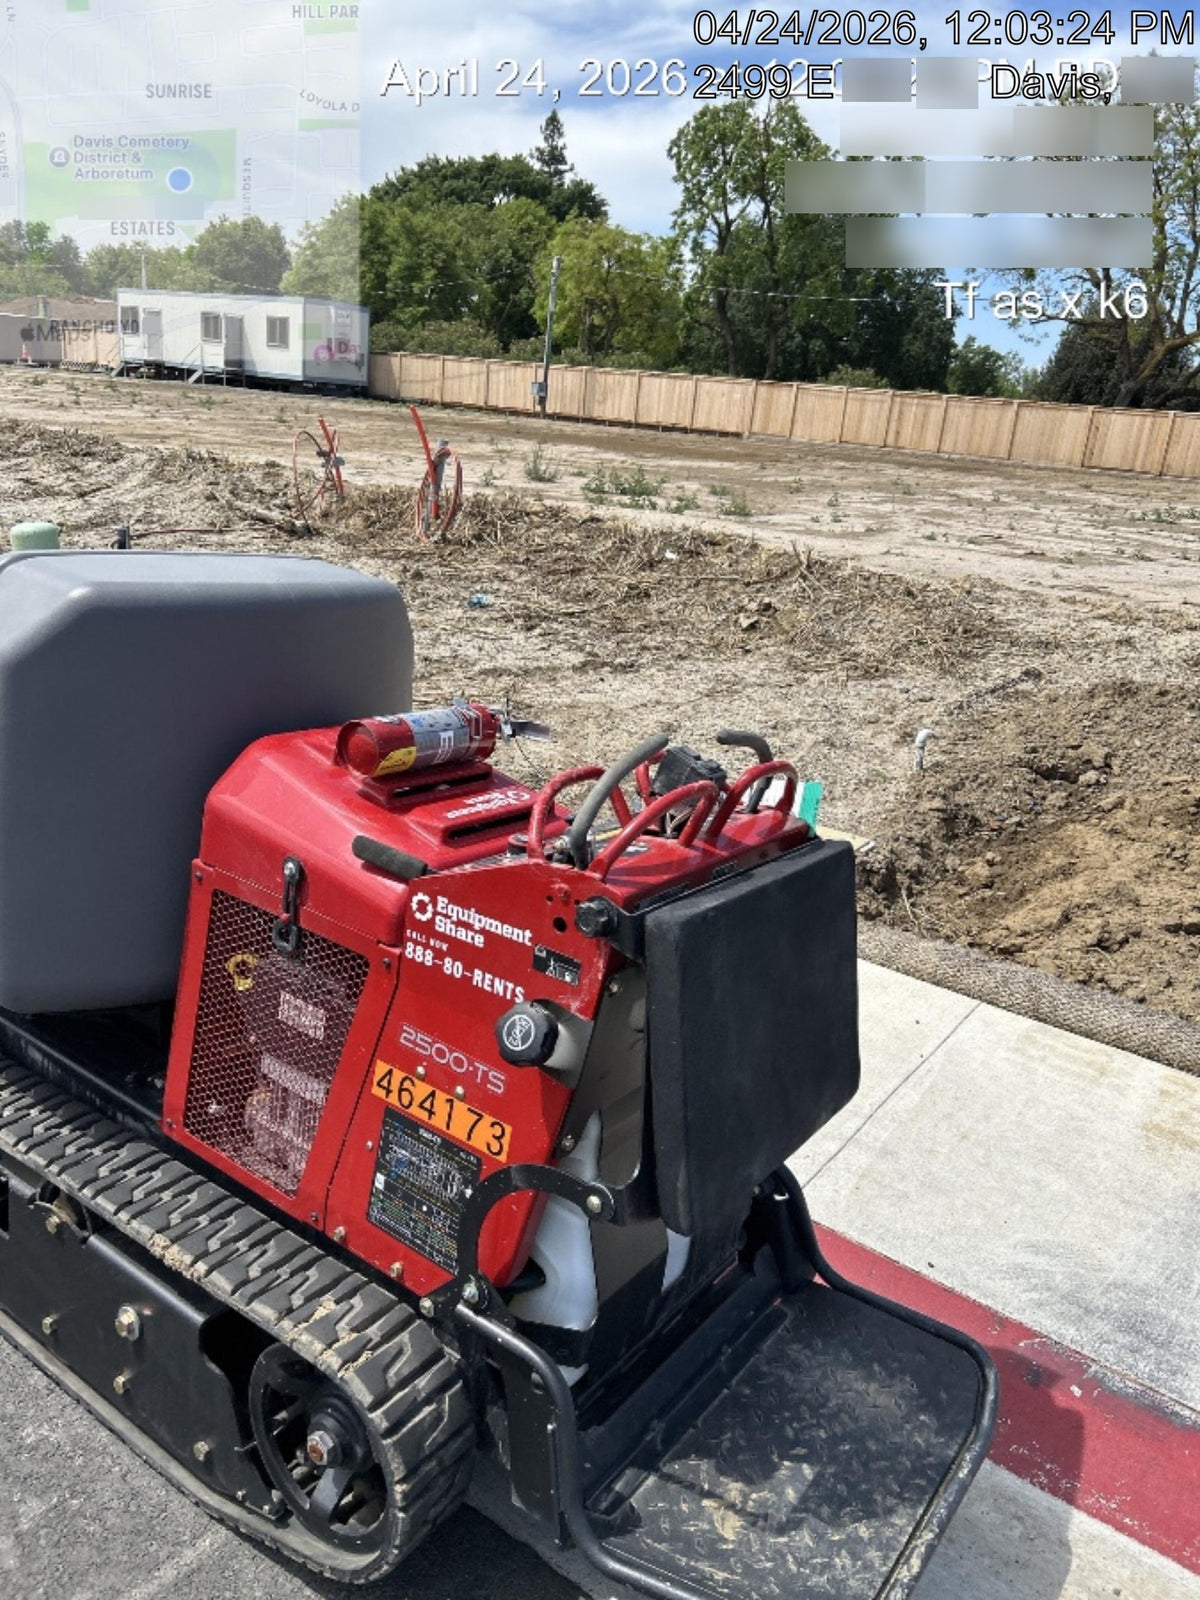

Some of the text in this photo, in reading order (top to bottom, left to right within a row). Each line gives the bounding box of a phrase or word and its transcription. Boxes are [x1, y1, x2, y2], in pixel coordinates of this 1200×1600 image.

[434, 915, 485, 948] Share
[436, 895, 533, 947] Equipment
[404, 941, 526, 1003] 888-80-RENTS
[376, 1068, 506, 1156] 464173
